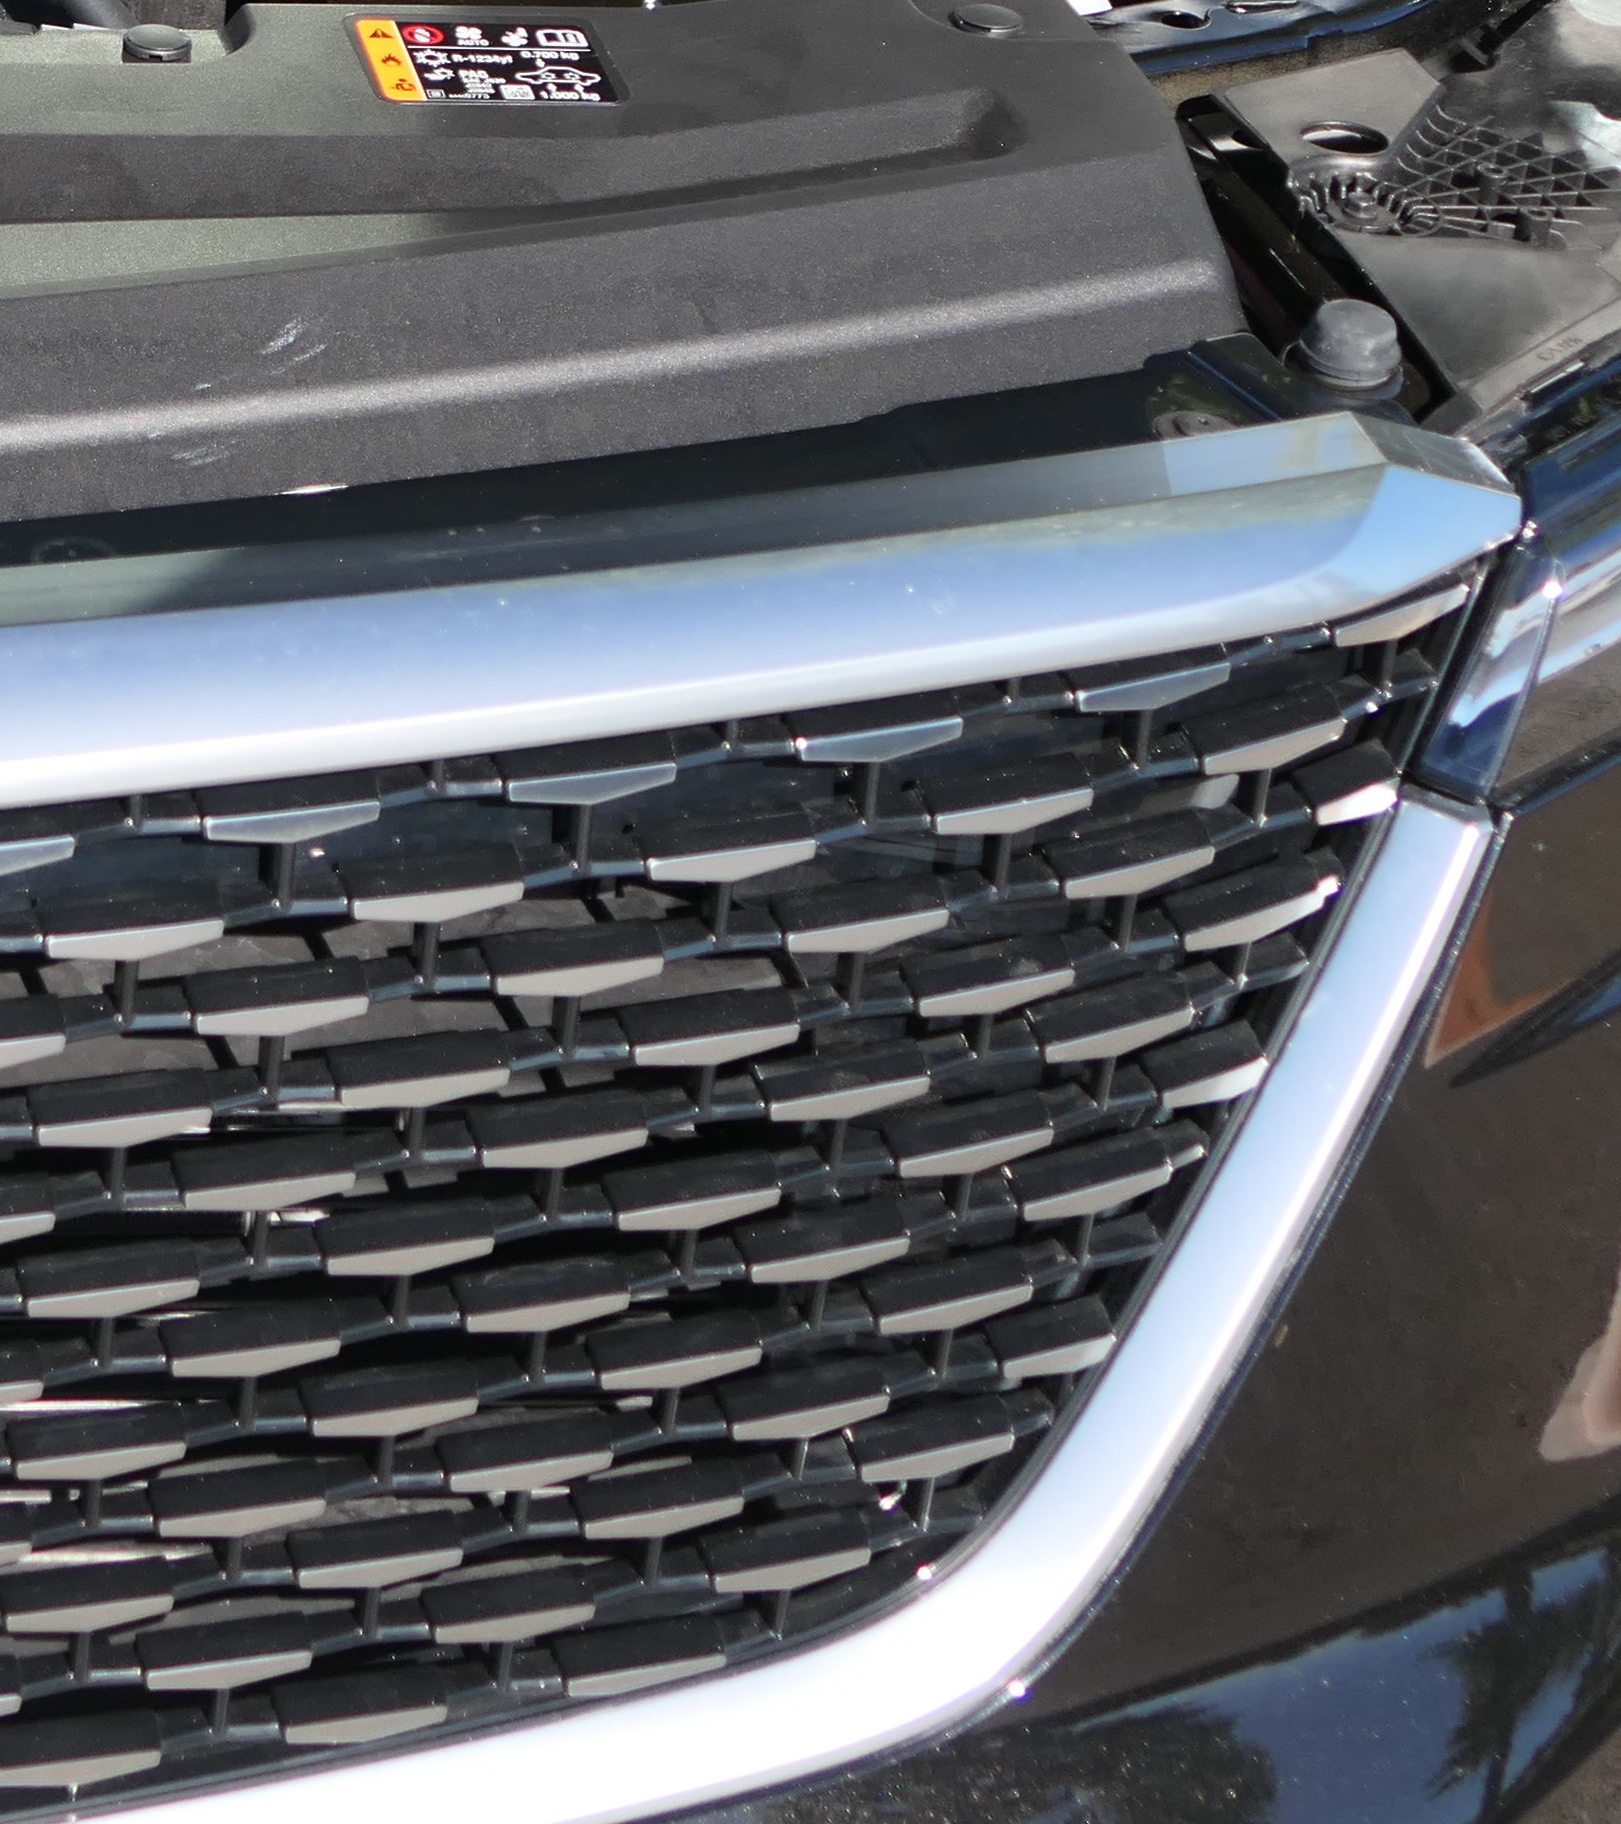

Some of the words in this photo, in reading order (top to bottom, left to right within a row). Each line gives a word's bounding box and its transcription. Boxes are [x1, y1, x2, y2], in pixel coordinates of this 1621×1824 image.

[457, 39, 490, 47] AUTO
[520, 50, 559, 59] 0.700
[540, 90, 580, 100] 1.000
